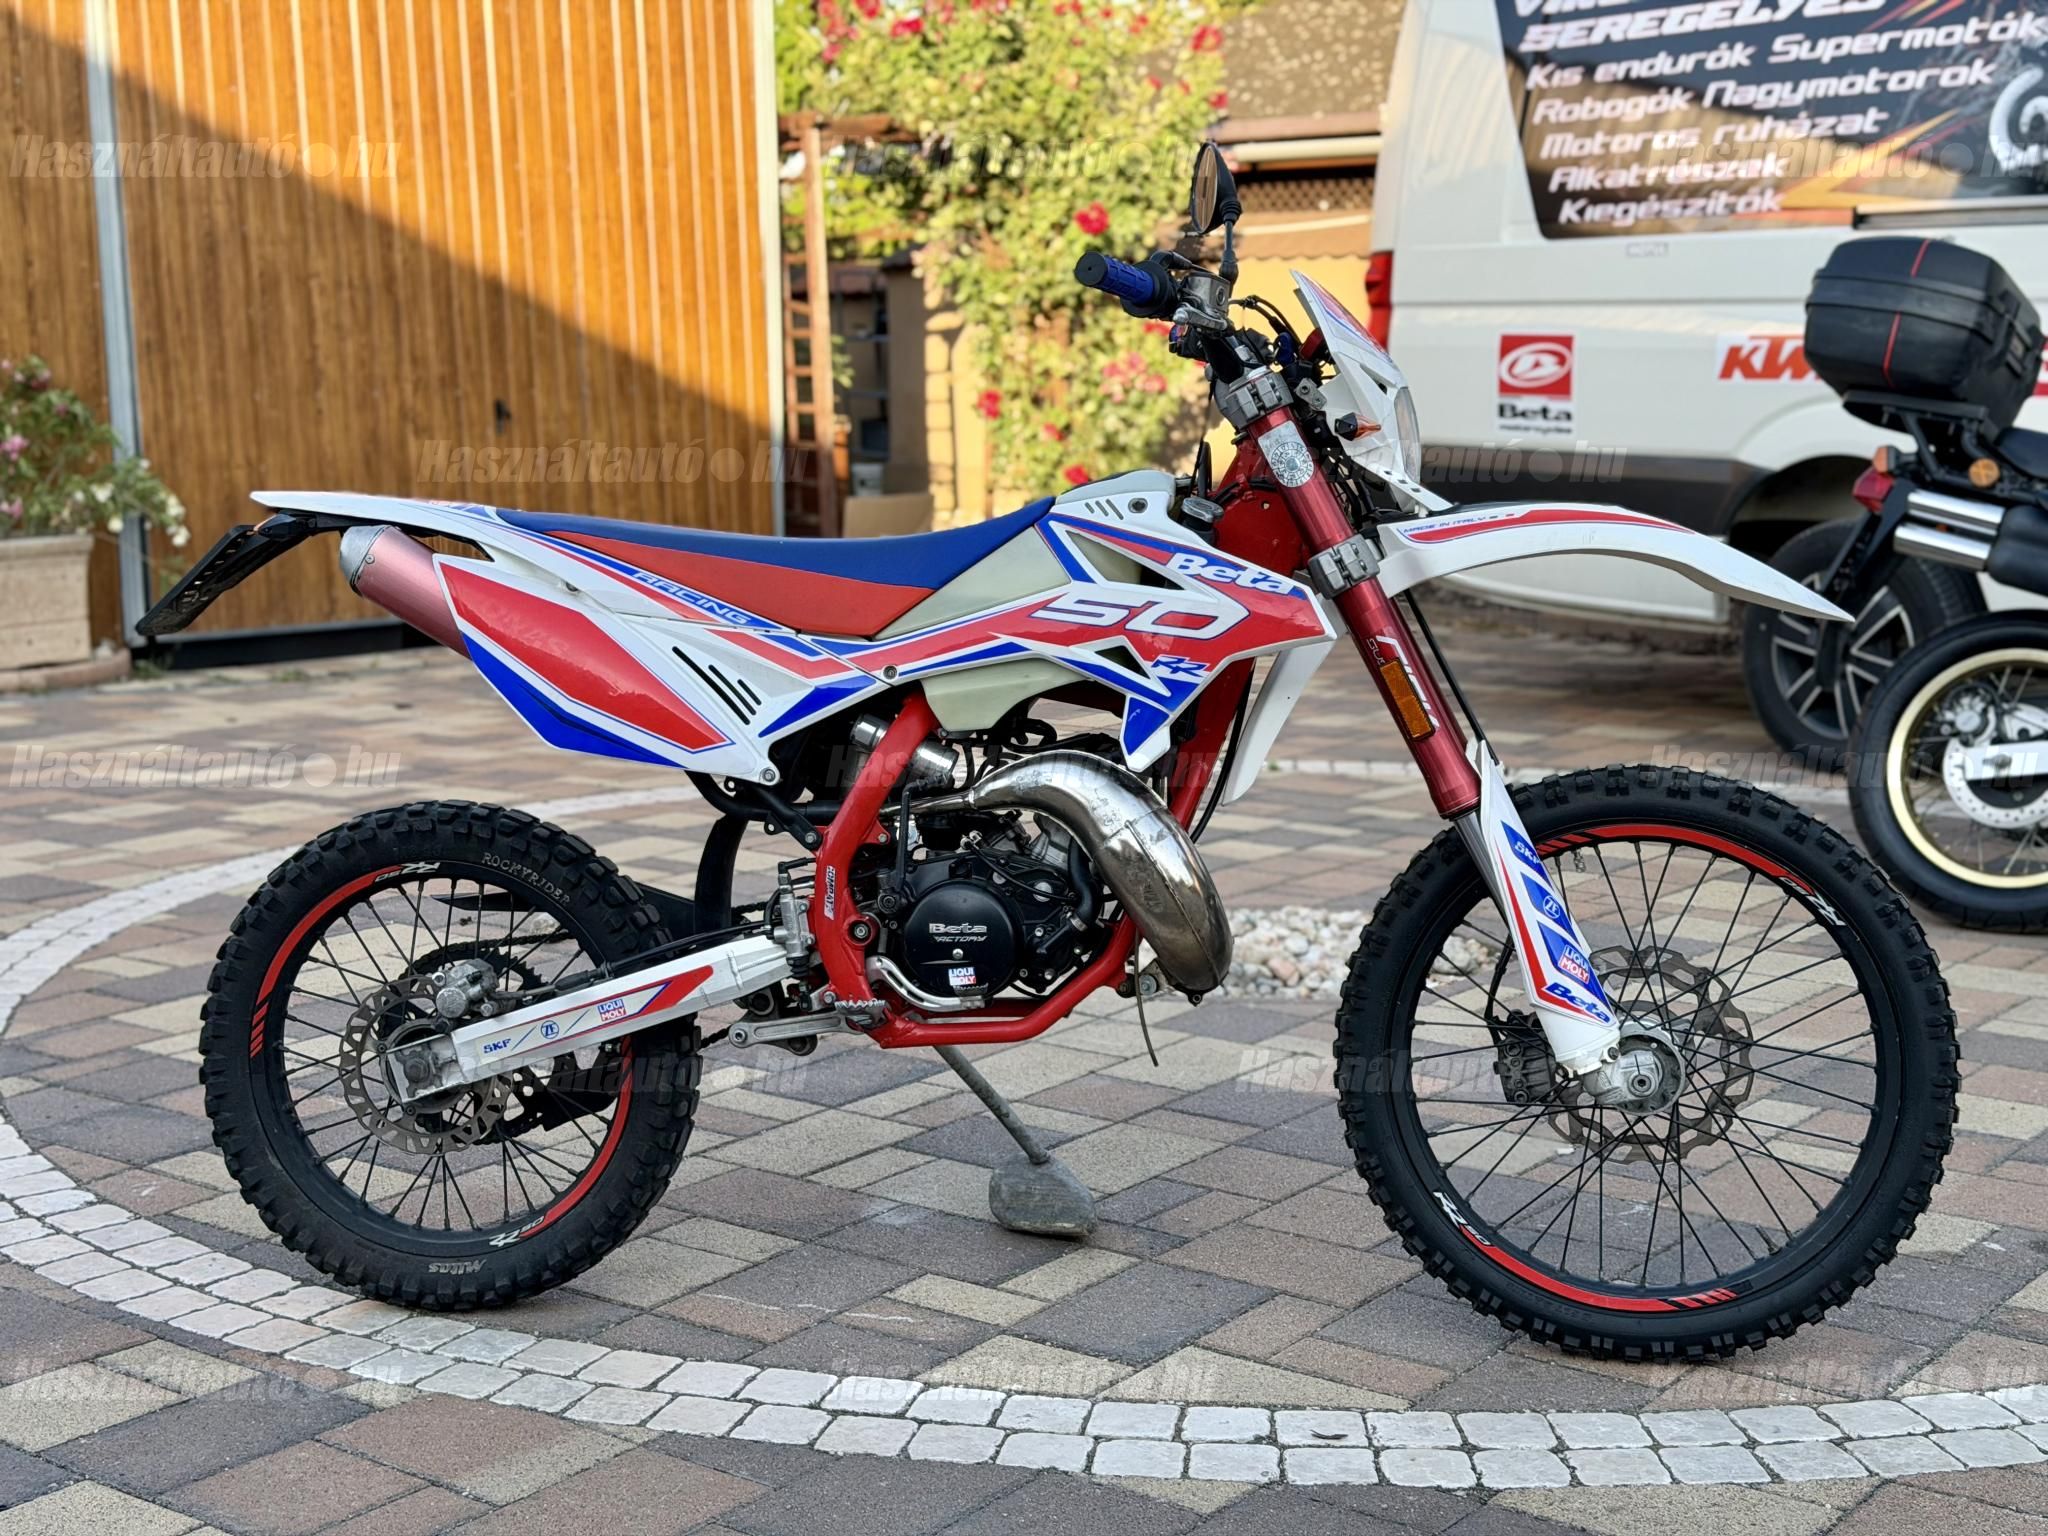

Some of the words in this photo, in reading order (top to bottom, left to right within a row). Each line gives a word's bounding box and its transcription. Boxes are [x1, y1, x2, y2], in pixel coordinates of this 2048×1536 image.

[1525, 62, 1585, 91] Kis
[1593, 40, 1757, 84] endurók
[1531, 86, 1696, 126] Robogók
[1701, 58, 1997, 110] Nagymotorok
[1539, 125, 1702, 160] Motoros
[1713, 105, 1890, 146] ruházat
[1498, 403, 1572, 421] Beta
[1166, 552, 1296, 596] Beta
[633, 571, 752, 625] RACING
[1029, 594, 1250, 640] 50
[1544, 898, 1560, 917] ZF
[929, 923, 987, 933] Beta
[948, 967, 975, 977] LIQUI
[950, 976, 976, 985] OLY
[1559, 959, 1589, 984] MOLY
[598, 1000, 624, 1014] LIQUI
[1545, 982, 1611, 1024] Beta
[600, 1007, 626, 1021] MOLY
[543, 1023, 557, 1036] ZF
[483, 1038, 512, 1055] SKF
